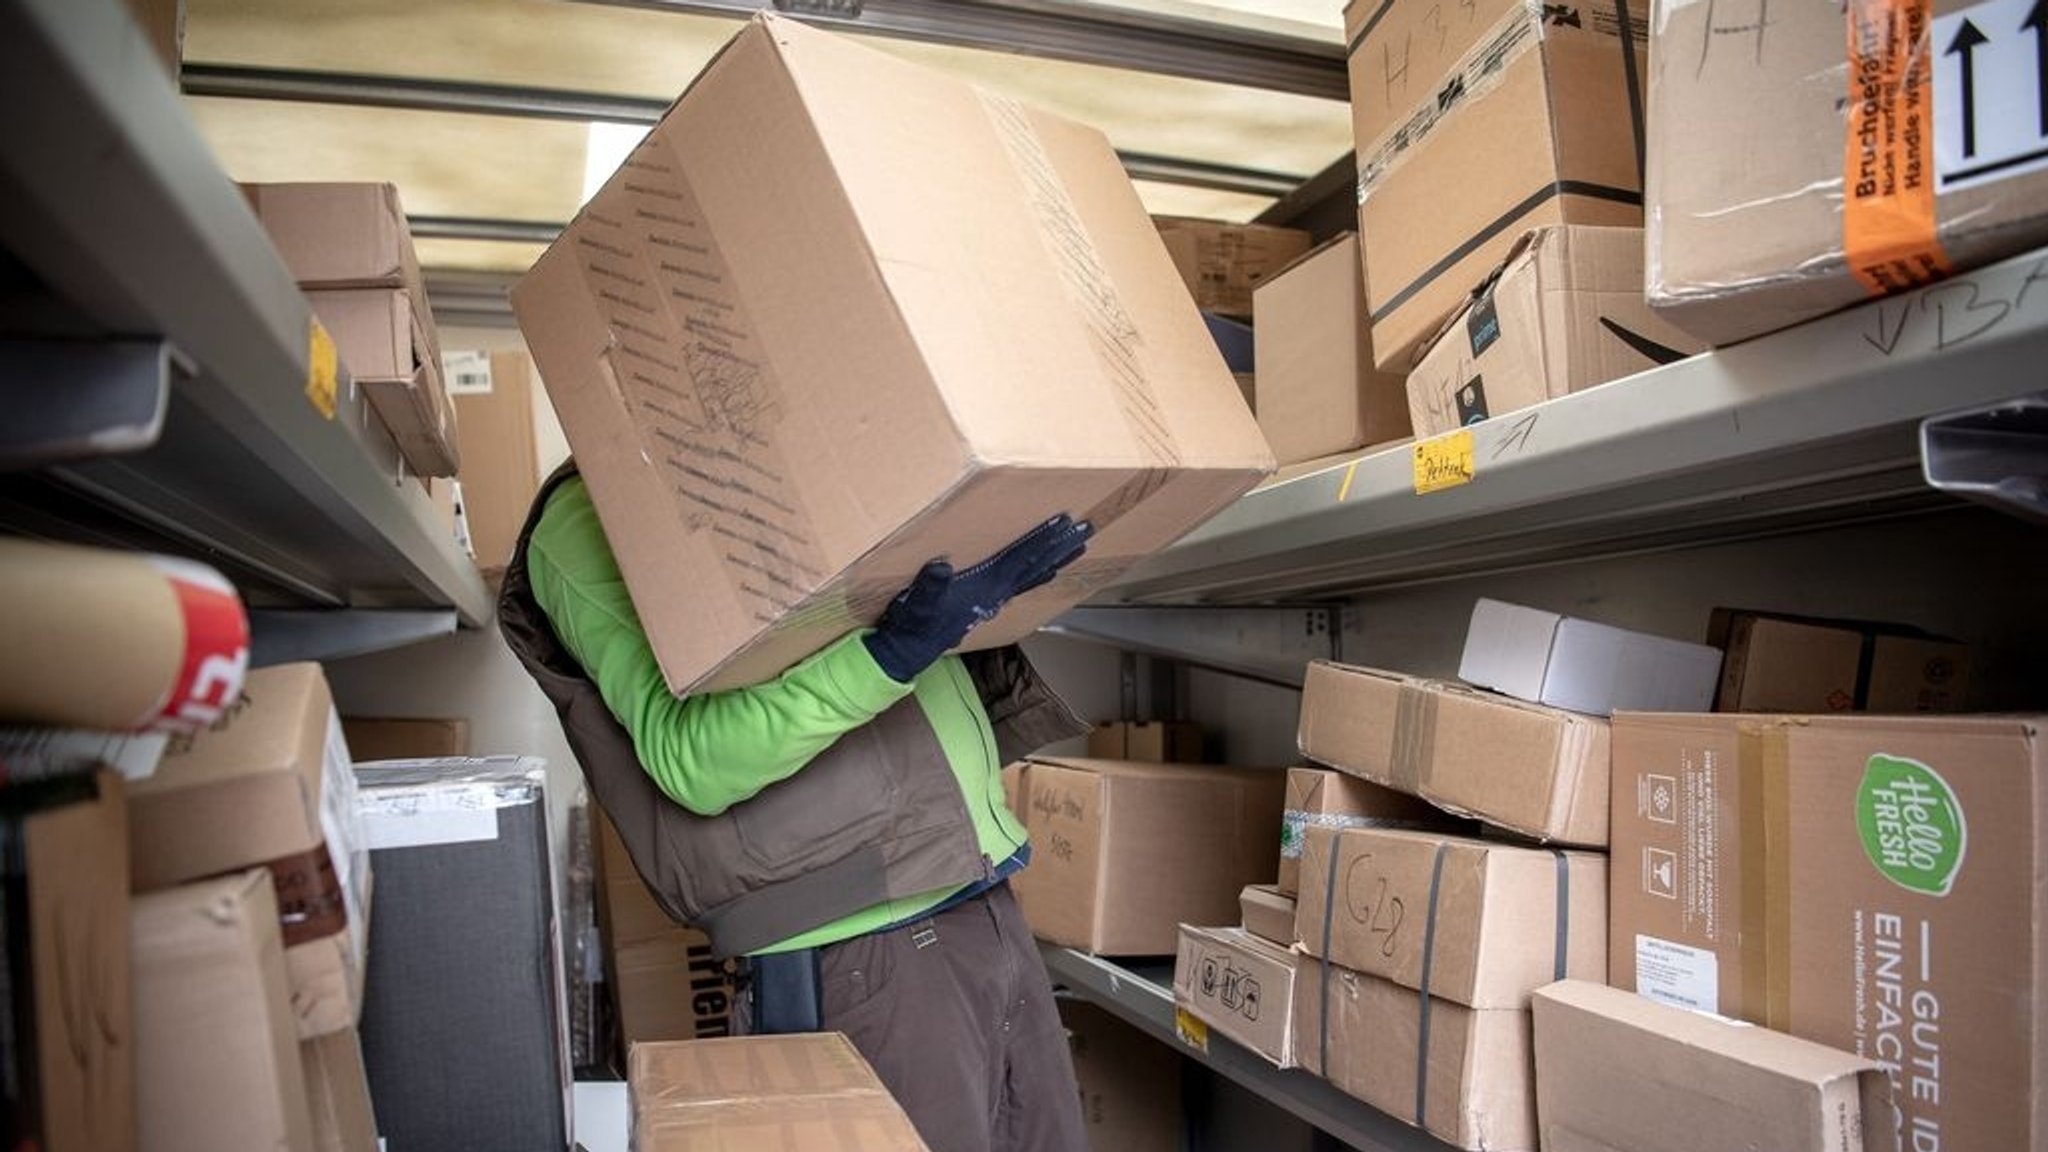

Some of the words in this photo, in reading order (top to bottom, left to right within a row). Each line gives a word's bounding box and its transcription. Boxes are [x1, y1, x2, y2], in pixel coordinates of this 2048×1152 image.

[1903, 113, 1921, 191] Handle
[1871, 787, 1909, 868] FRESH
[1889, 774, 1944, 872] Hello
[1910, 989, 1941, 1104] GUTE
